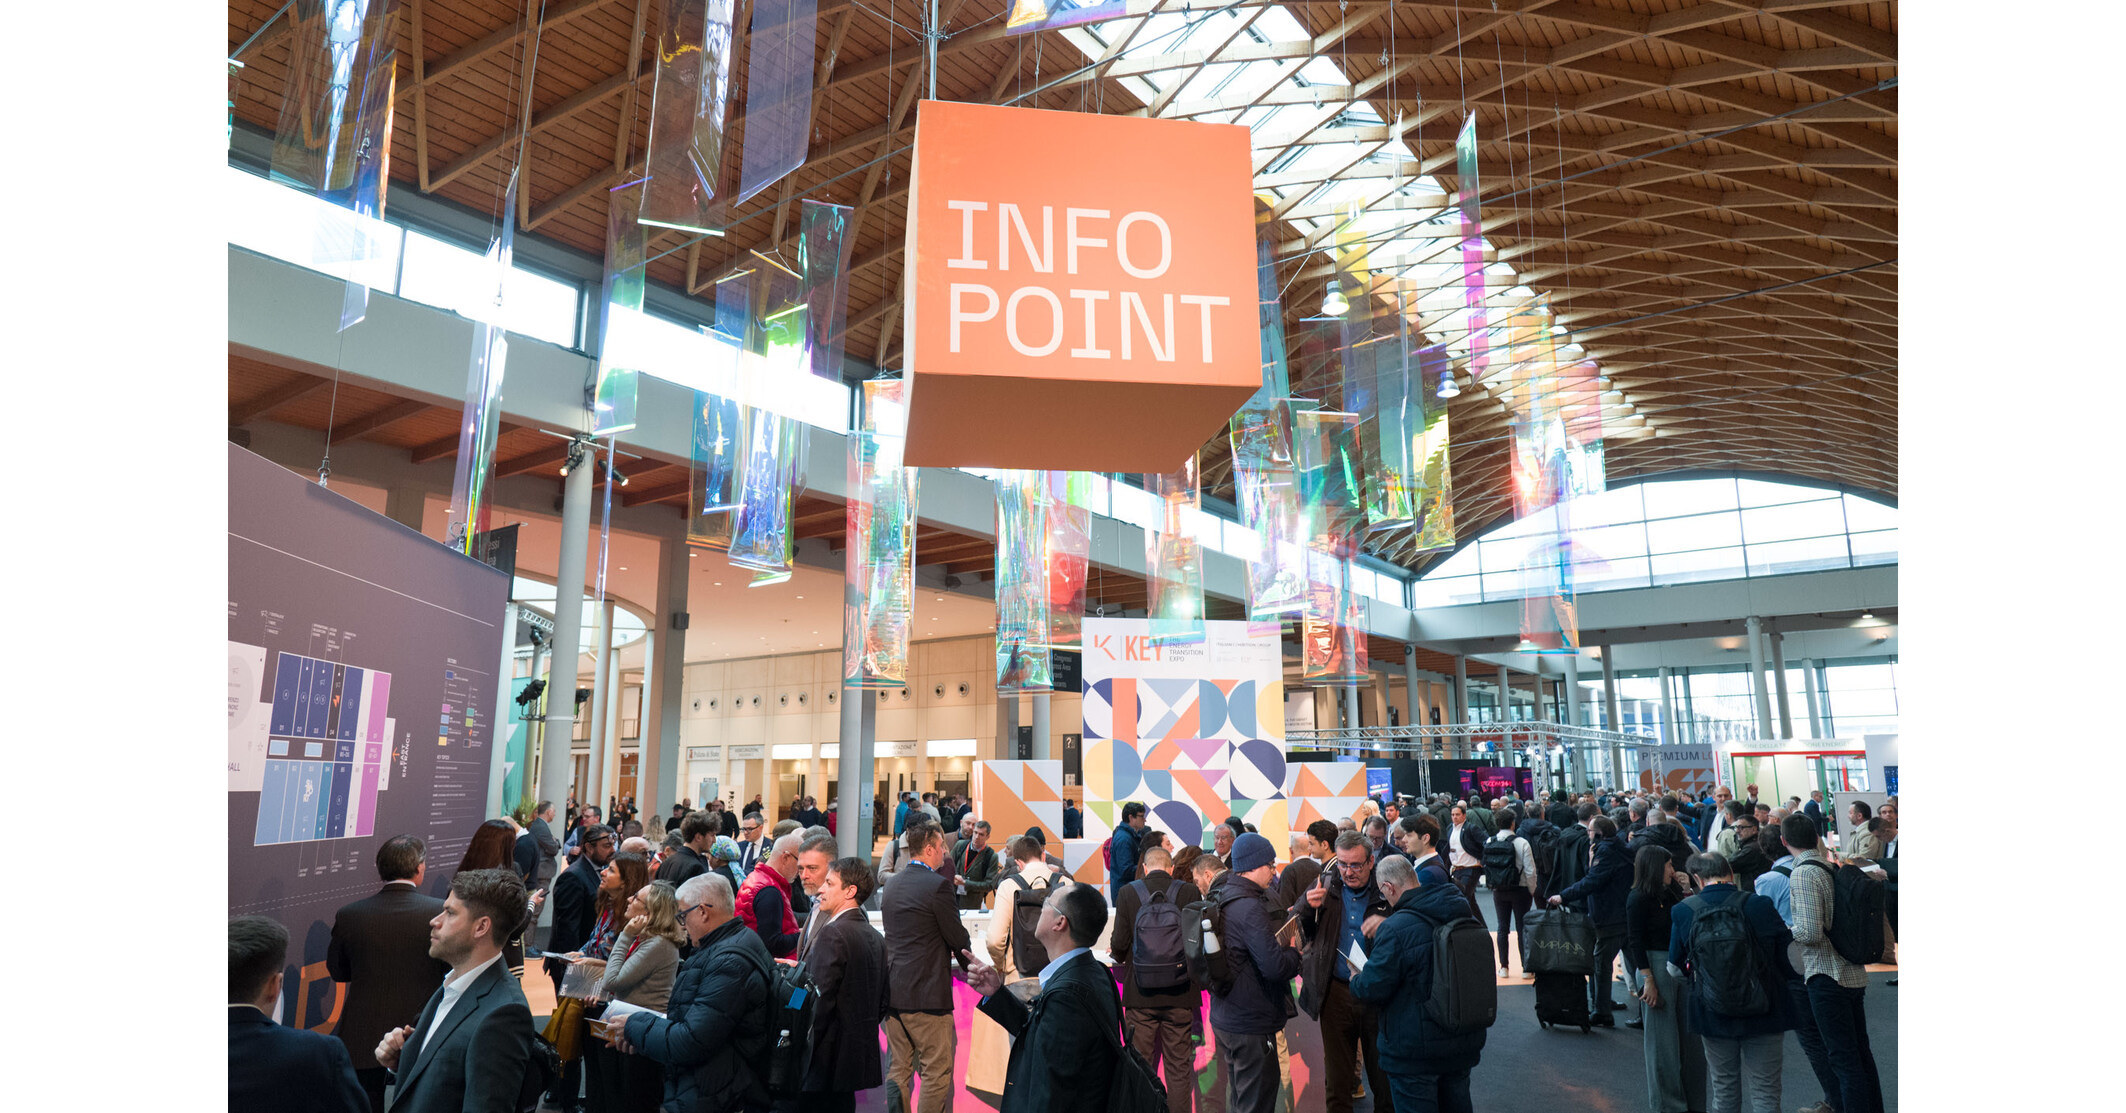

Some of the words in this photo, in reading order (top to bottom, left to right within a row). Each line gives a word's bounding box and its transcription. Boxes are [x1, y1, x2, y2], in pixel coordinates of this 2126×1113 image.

[946, 200, 1172, 280] INFO
[950, 283, 1231, 364] POINT
[1125, 635, 1165, 662] KEY
[402, 732, 412, 778] ENTRANCE
